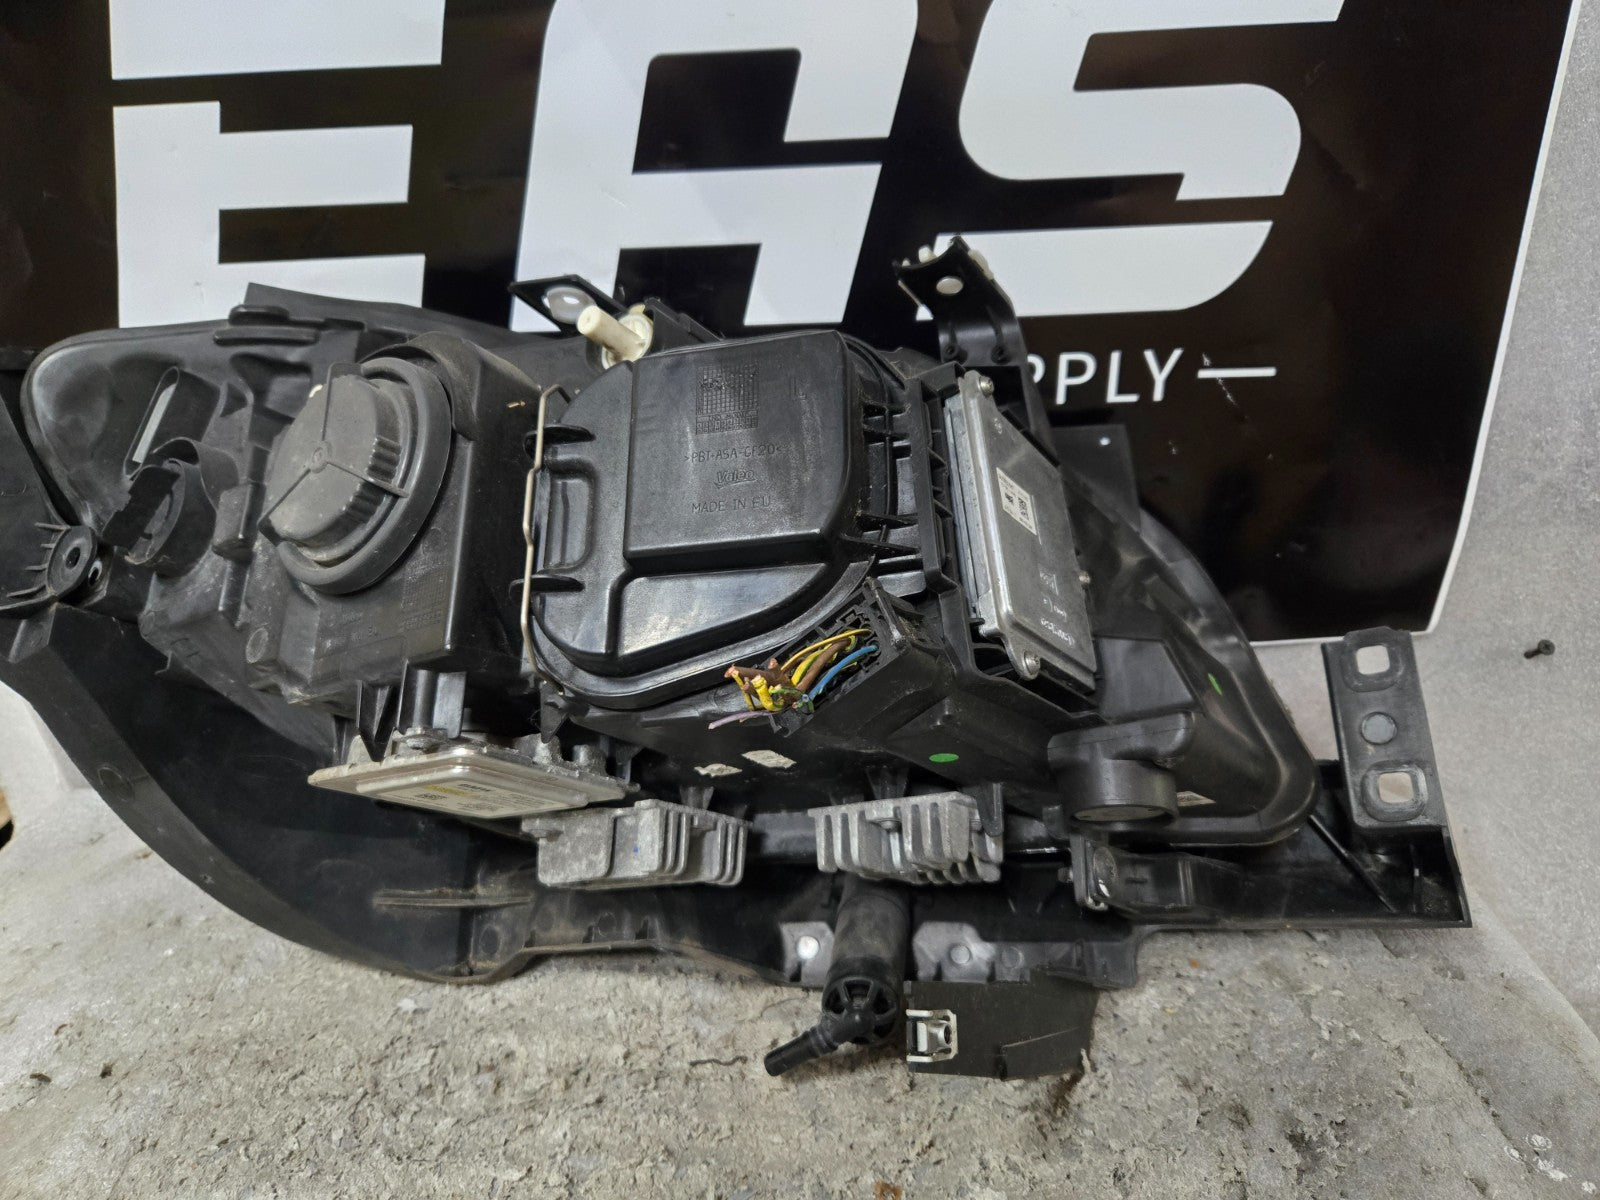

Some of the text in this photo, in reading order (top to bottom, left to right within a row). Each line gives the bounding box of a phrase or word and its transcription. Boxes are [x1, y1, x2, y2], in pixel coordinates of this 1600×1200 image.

[691, 495, 772, 514] MADE IN EU
